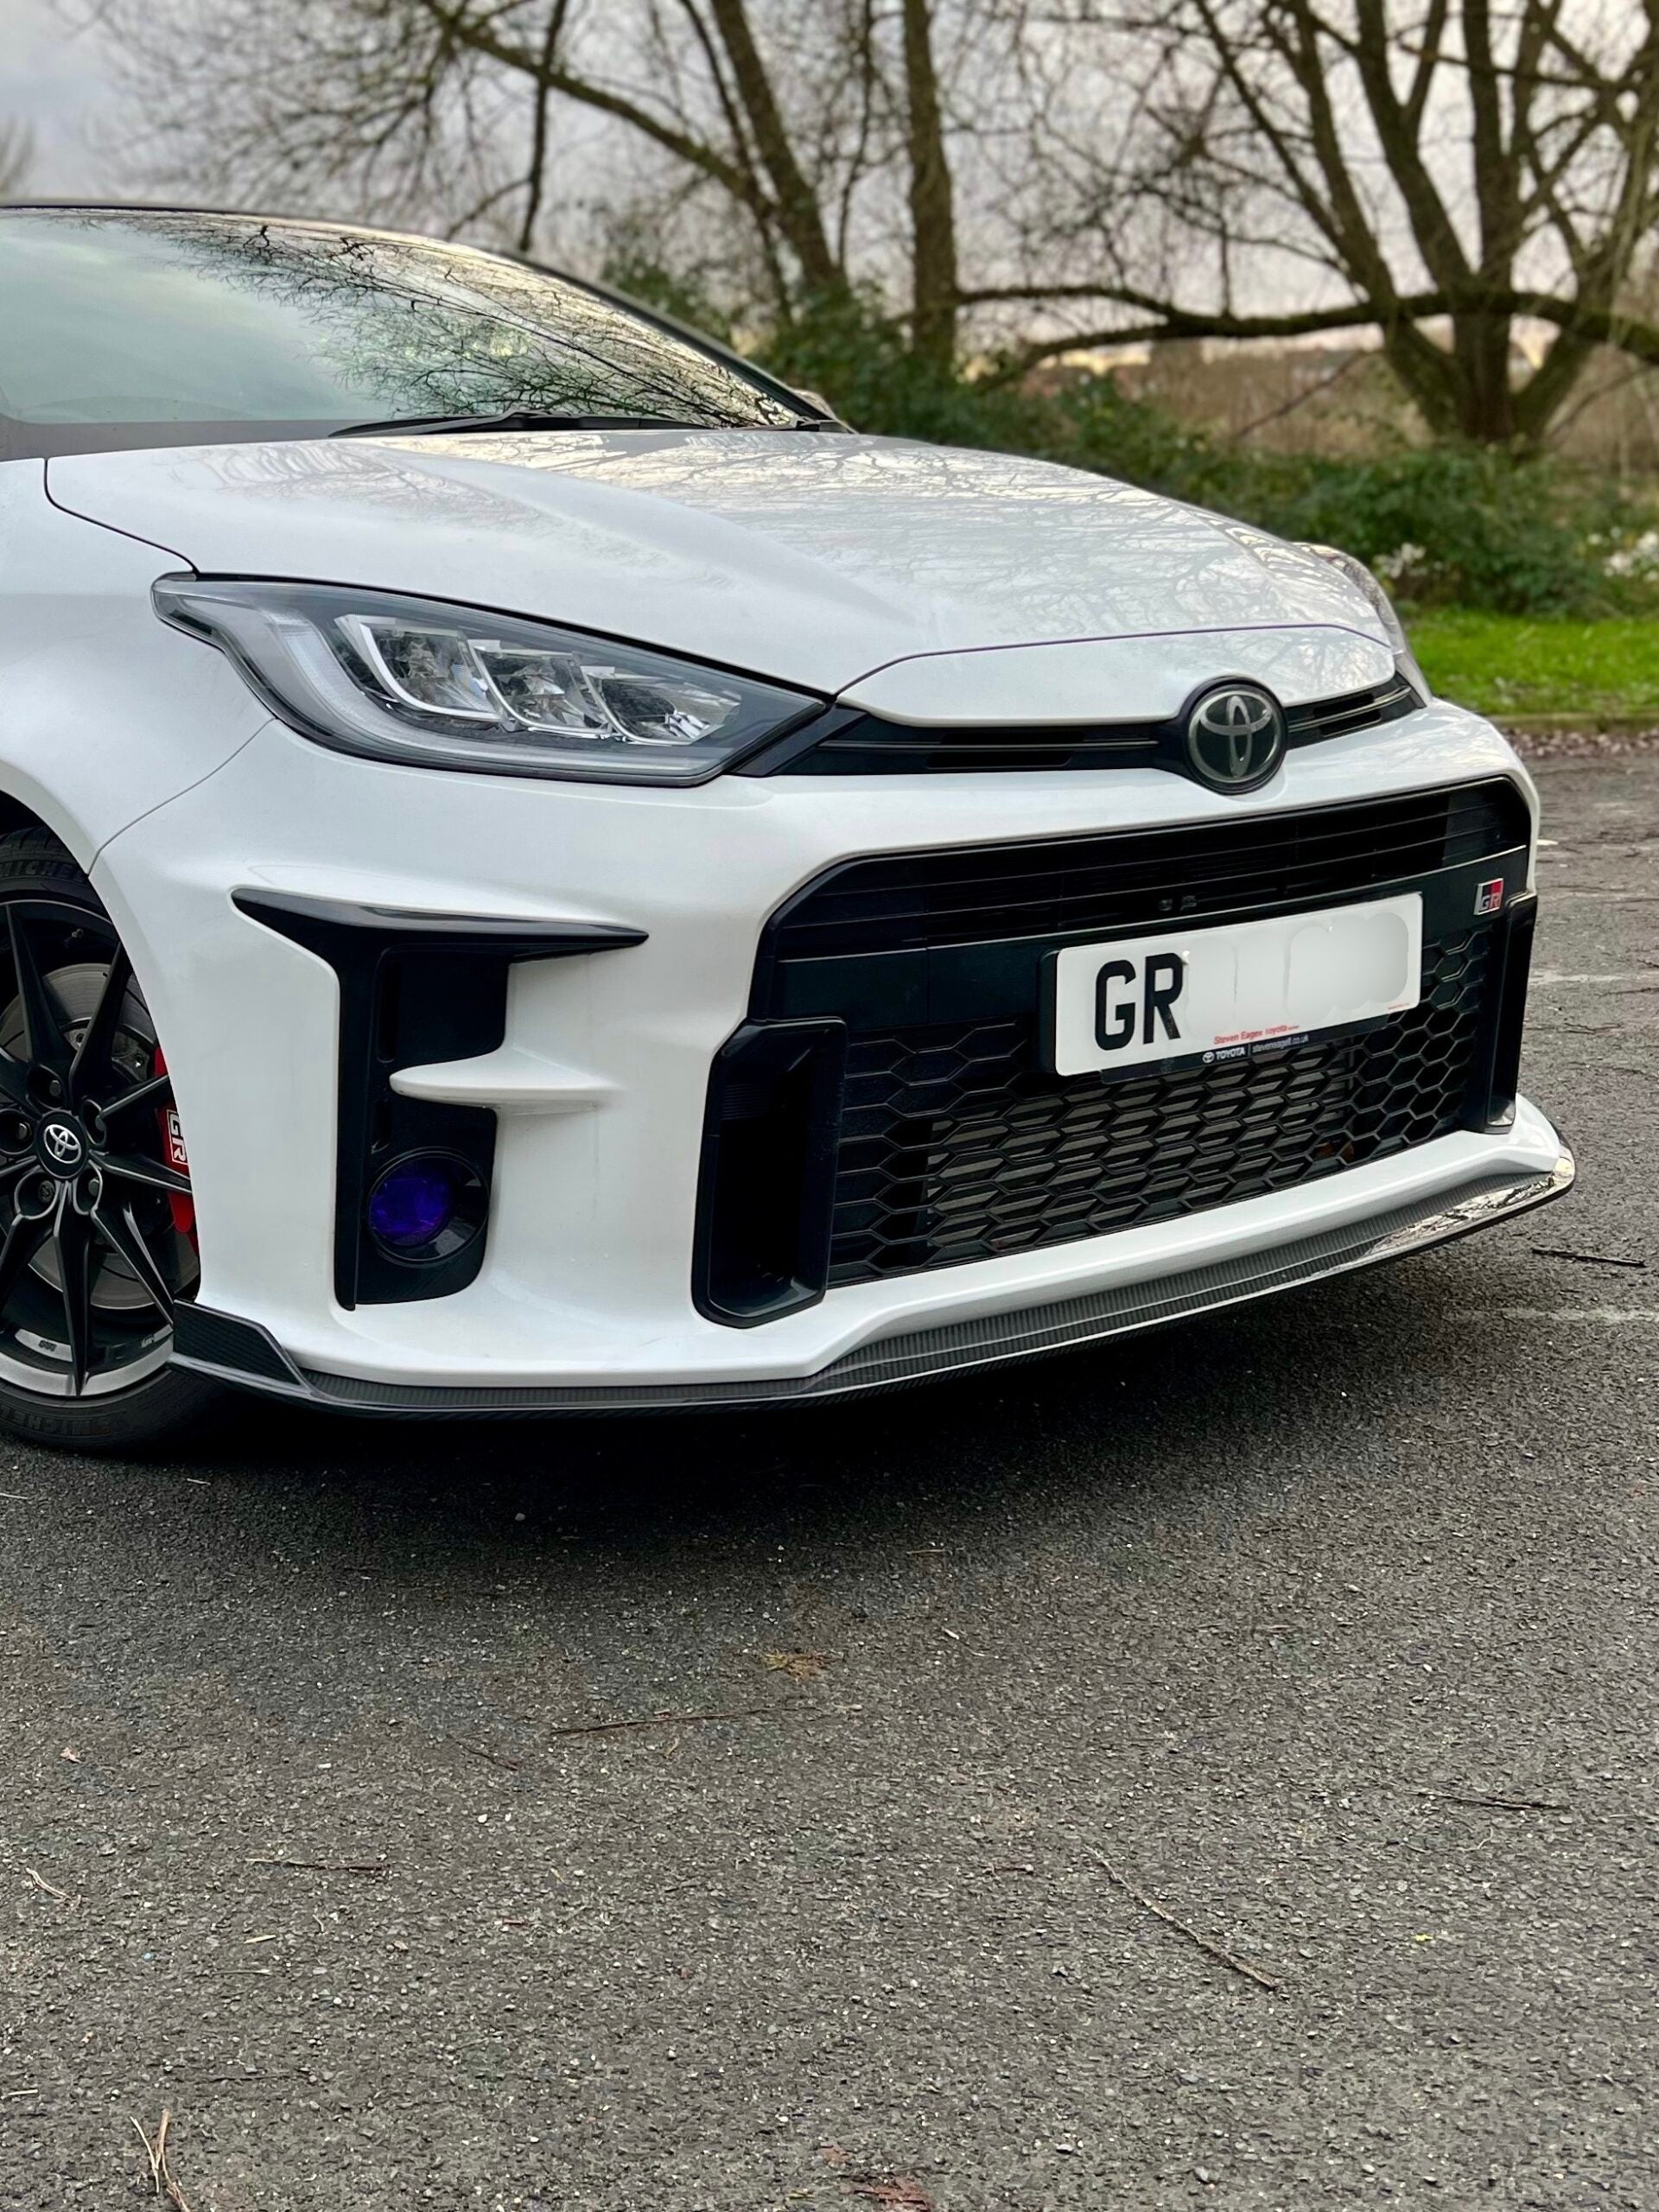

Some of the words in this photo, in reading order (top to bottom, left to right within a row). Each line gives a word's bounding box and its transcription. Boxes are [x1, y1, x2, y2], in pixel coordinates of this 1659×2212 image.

[1479, 892, 1502, 911] GR
[1095, 952, 1184, 1051] GR
[1216, 1047, 1246, 1060] TOYOTA
[170, 1114, 187, 1162] GR
